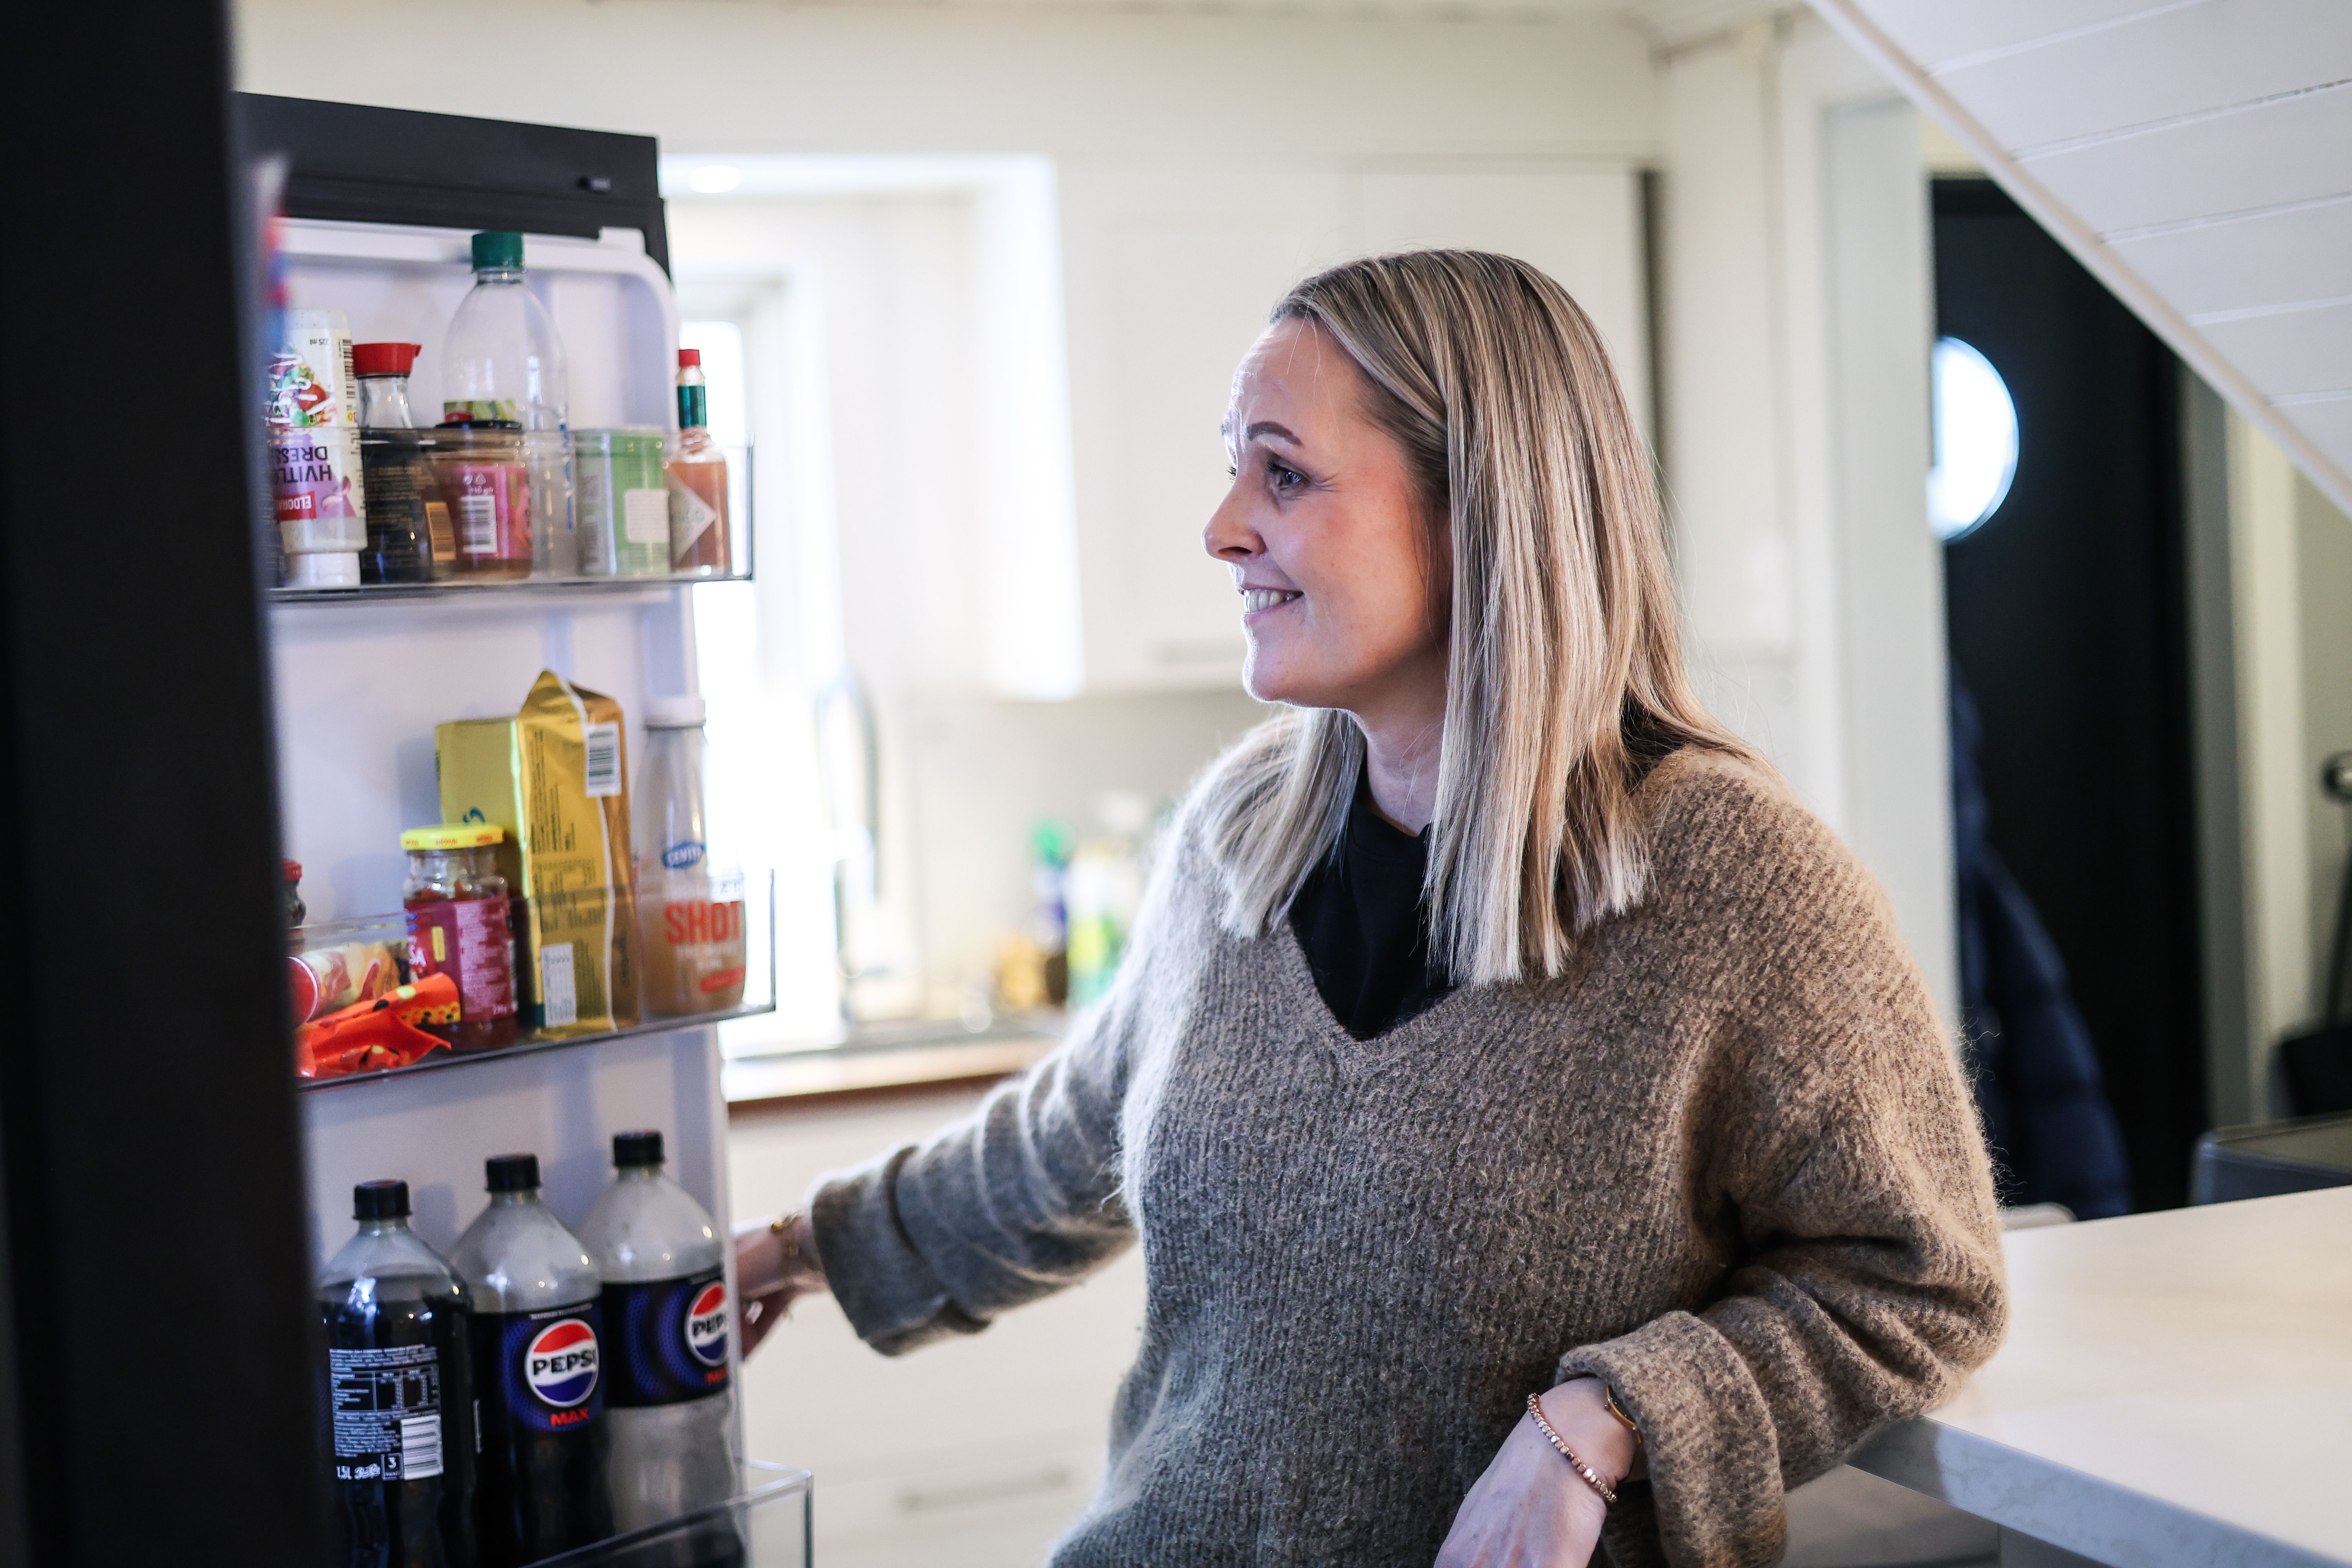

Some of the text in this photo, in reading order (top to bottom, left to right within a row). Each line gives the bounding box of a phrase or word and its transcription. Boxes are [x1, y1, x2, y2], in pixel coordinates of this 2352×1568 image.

[665, 900, 741, 945] SHOT
[408, 943, 427, 967] SA
[692, 1312, 726, 1338] PEP
[533, 1348, 598, 1377] PEPSI
[705, 1365, 728, 1385] MA
[550, 1406, 590, 1427] MAX
[388, 1457, 397, 1469] 3
